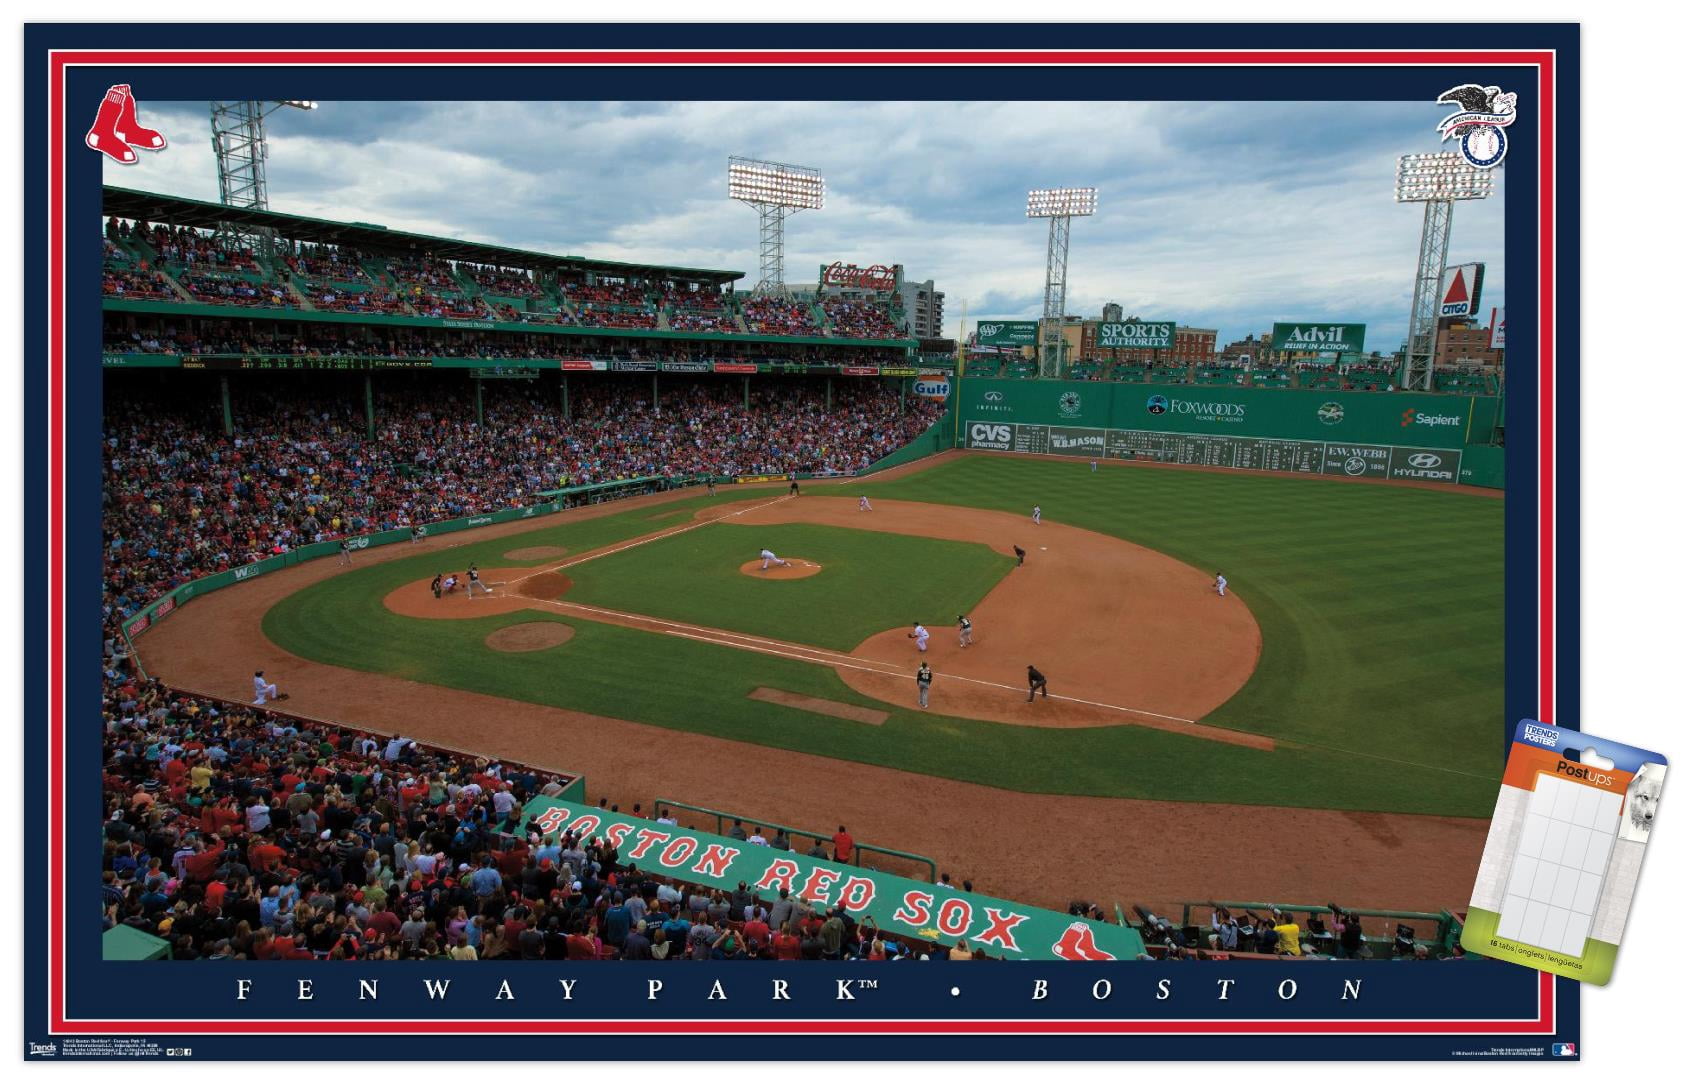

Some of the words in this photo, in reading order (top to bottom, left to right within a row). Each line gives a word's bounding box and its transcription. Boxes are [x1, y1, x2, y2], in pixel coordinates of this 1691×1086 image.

[1442, 302, 1468, 314] CITGO
[1101, 324, 1170, 339] SPORTS
[1287, 326, 1344, 342] Advil
[1284, 342, 1307, 350] RELIEF
[914, 382, 948, 395] Gulf
[1171, 400, 1246, 417] FOXWOODS
[1415, 412, 1460, 427] Sapient
[971, 424, 1011, 442] CVS
[971, 439, 1010, 451] pharmacy
[1351, 448, 1387, 458] WEBB
[1394, 469, 1453, 480] HYUNDAI
[1526, 725, 1559, 740] TRENDS
[1524, 734, 1556, 747] POSTERS
[1557, 761, 1613, 786] Postups
[536, 806, 741, 878] BOSTON
[753, 858, 876, 912] RED
[893, 890, 1031, 953] SOX
[1490, 939, 1498, 947] 16
[1499, 942, 1515, 952] tabs
[1518, 947, 1545, 960] onglets
[1547, 954, 1583, 970] lengüetas
[237, 979, 576, 1000] FENWAY
[1032, 979, 1362, 1000] BOSTON
[29, 1042, 57, 1051] Trends
